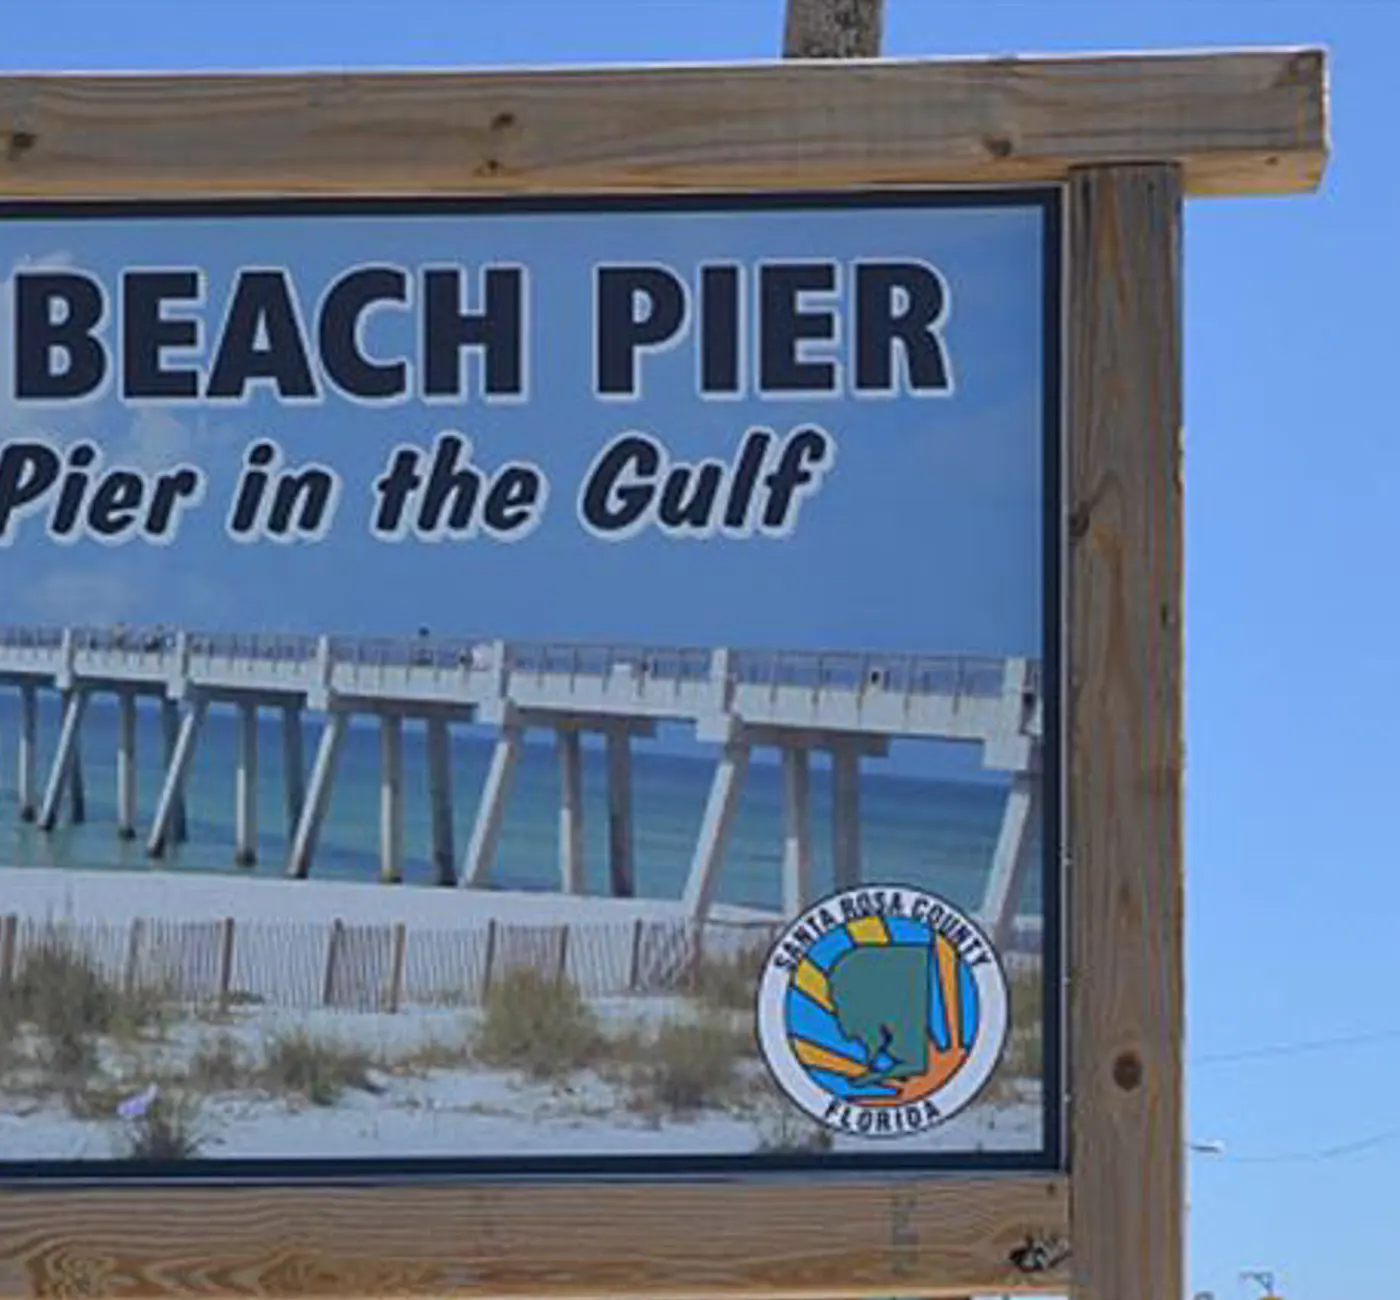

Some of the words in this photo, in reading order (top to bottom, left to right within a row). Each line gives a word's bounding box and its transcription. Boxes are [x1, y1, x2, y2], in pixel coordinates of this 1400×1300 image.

[13, 266, 524, 399] BEACH
[597, 262, 949, 395] PIER
[0, 442, 199, 536] Pier
[230, 442, 332, 535] in
[375, 434, 540, 533] the
[582, 429, 828, 531] Gulf
[774, 908, 836, 969] SANTA
[840, 892, 905, 920] ROSA
[911, 897, 992, 967] COUNTY
[825, 1100, 941, 1132] FLORIDA
